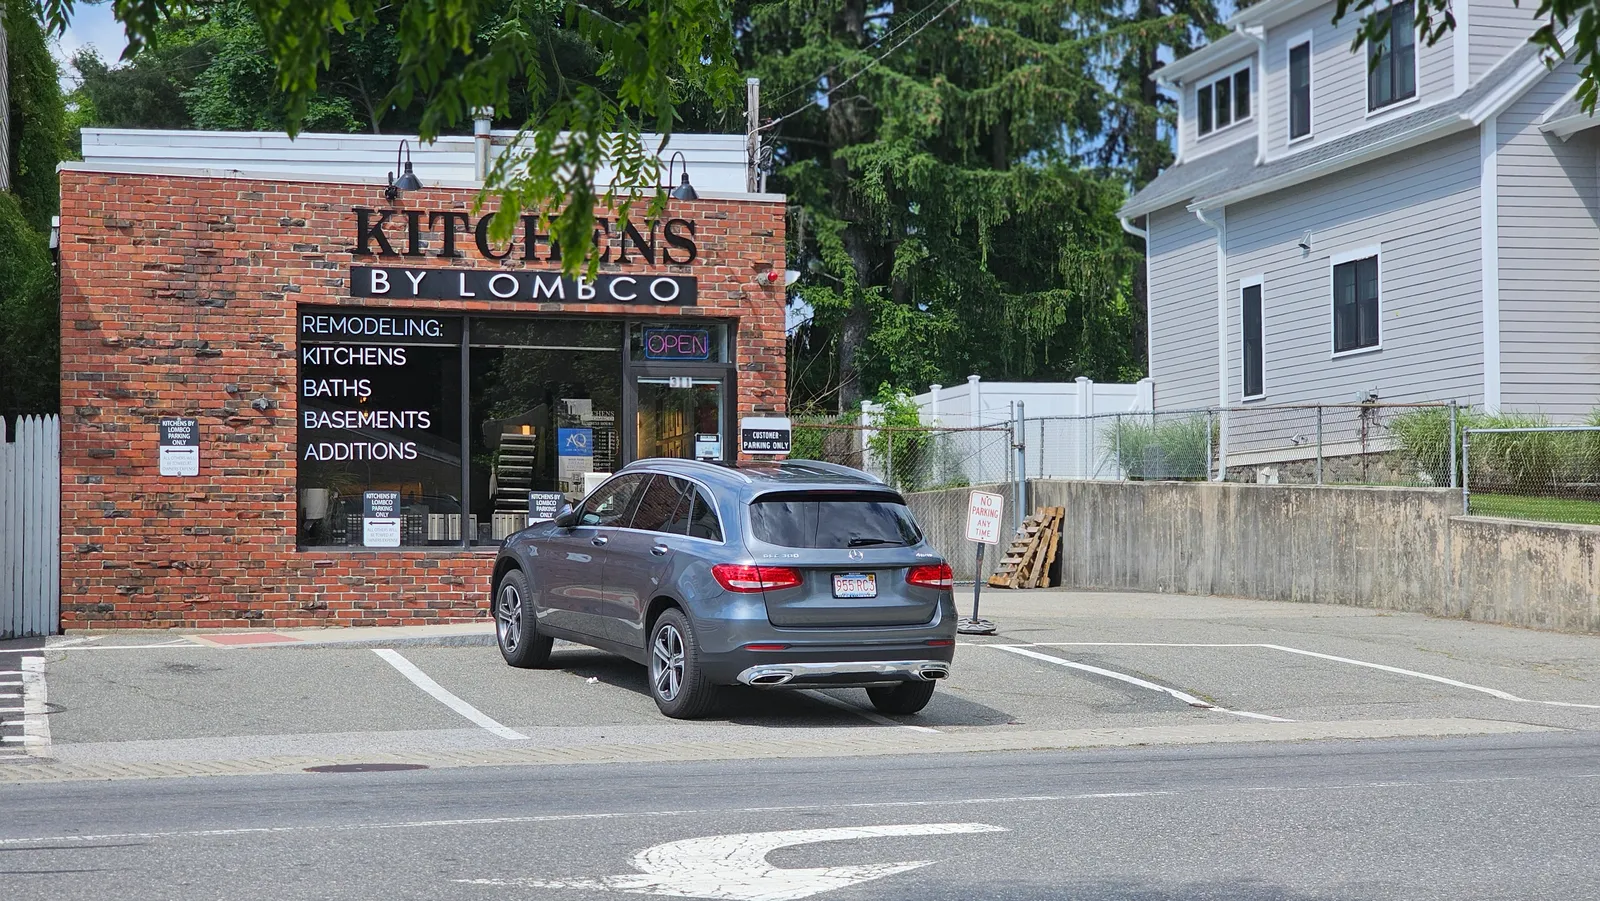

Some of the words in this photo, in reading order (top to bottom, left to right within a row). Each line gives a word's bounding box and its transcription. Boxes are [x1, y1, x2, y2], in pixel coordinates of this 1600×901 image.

[371, 270, 427, 295] BY
[460, 273, 680, 301] LOMBCO
[302, 316, 443, 337] REMODELING:
[648, 335, 707, 354] OPEN
[303, 347, 407, 365] KITCHENS
[303, 379, 372, 397] BATHS
[304, 411, 431, 429] BASEMENTS
[304, 442, 417, 460] ADDITIONS
[744, 442, 770, 450] PARKING
[772, 442, 788, 450] ONLY
[981, 497, 992, 506] NO
[972, 506, 999, 518] PARKING
[976, 528, 990, 537] TIME
[836, 580, 854, 592] 955
[856, 580, 874, 592] RC3
